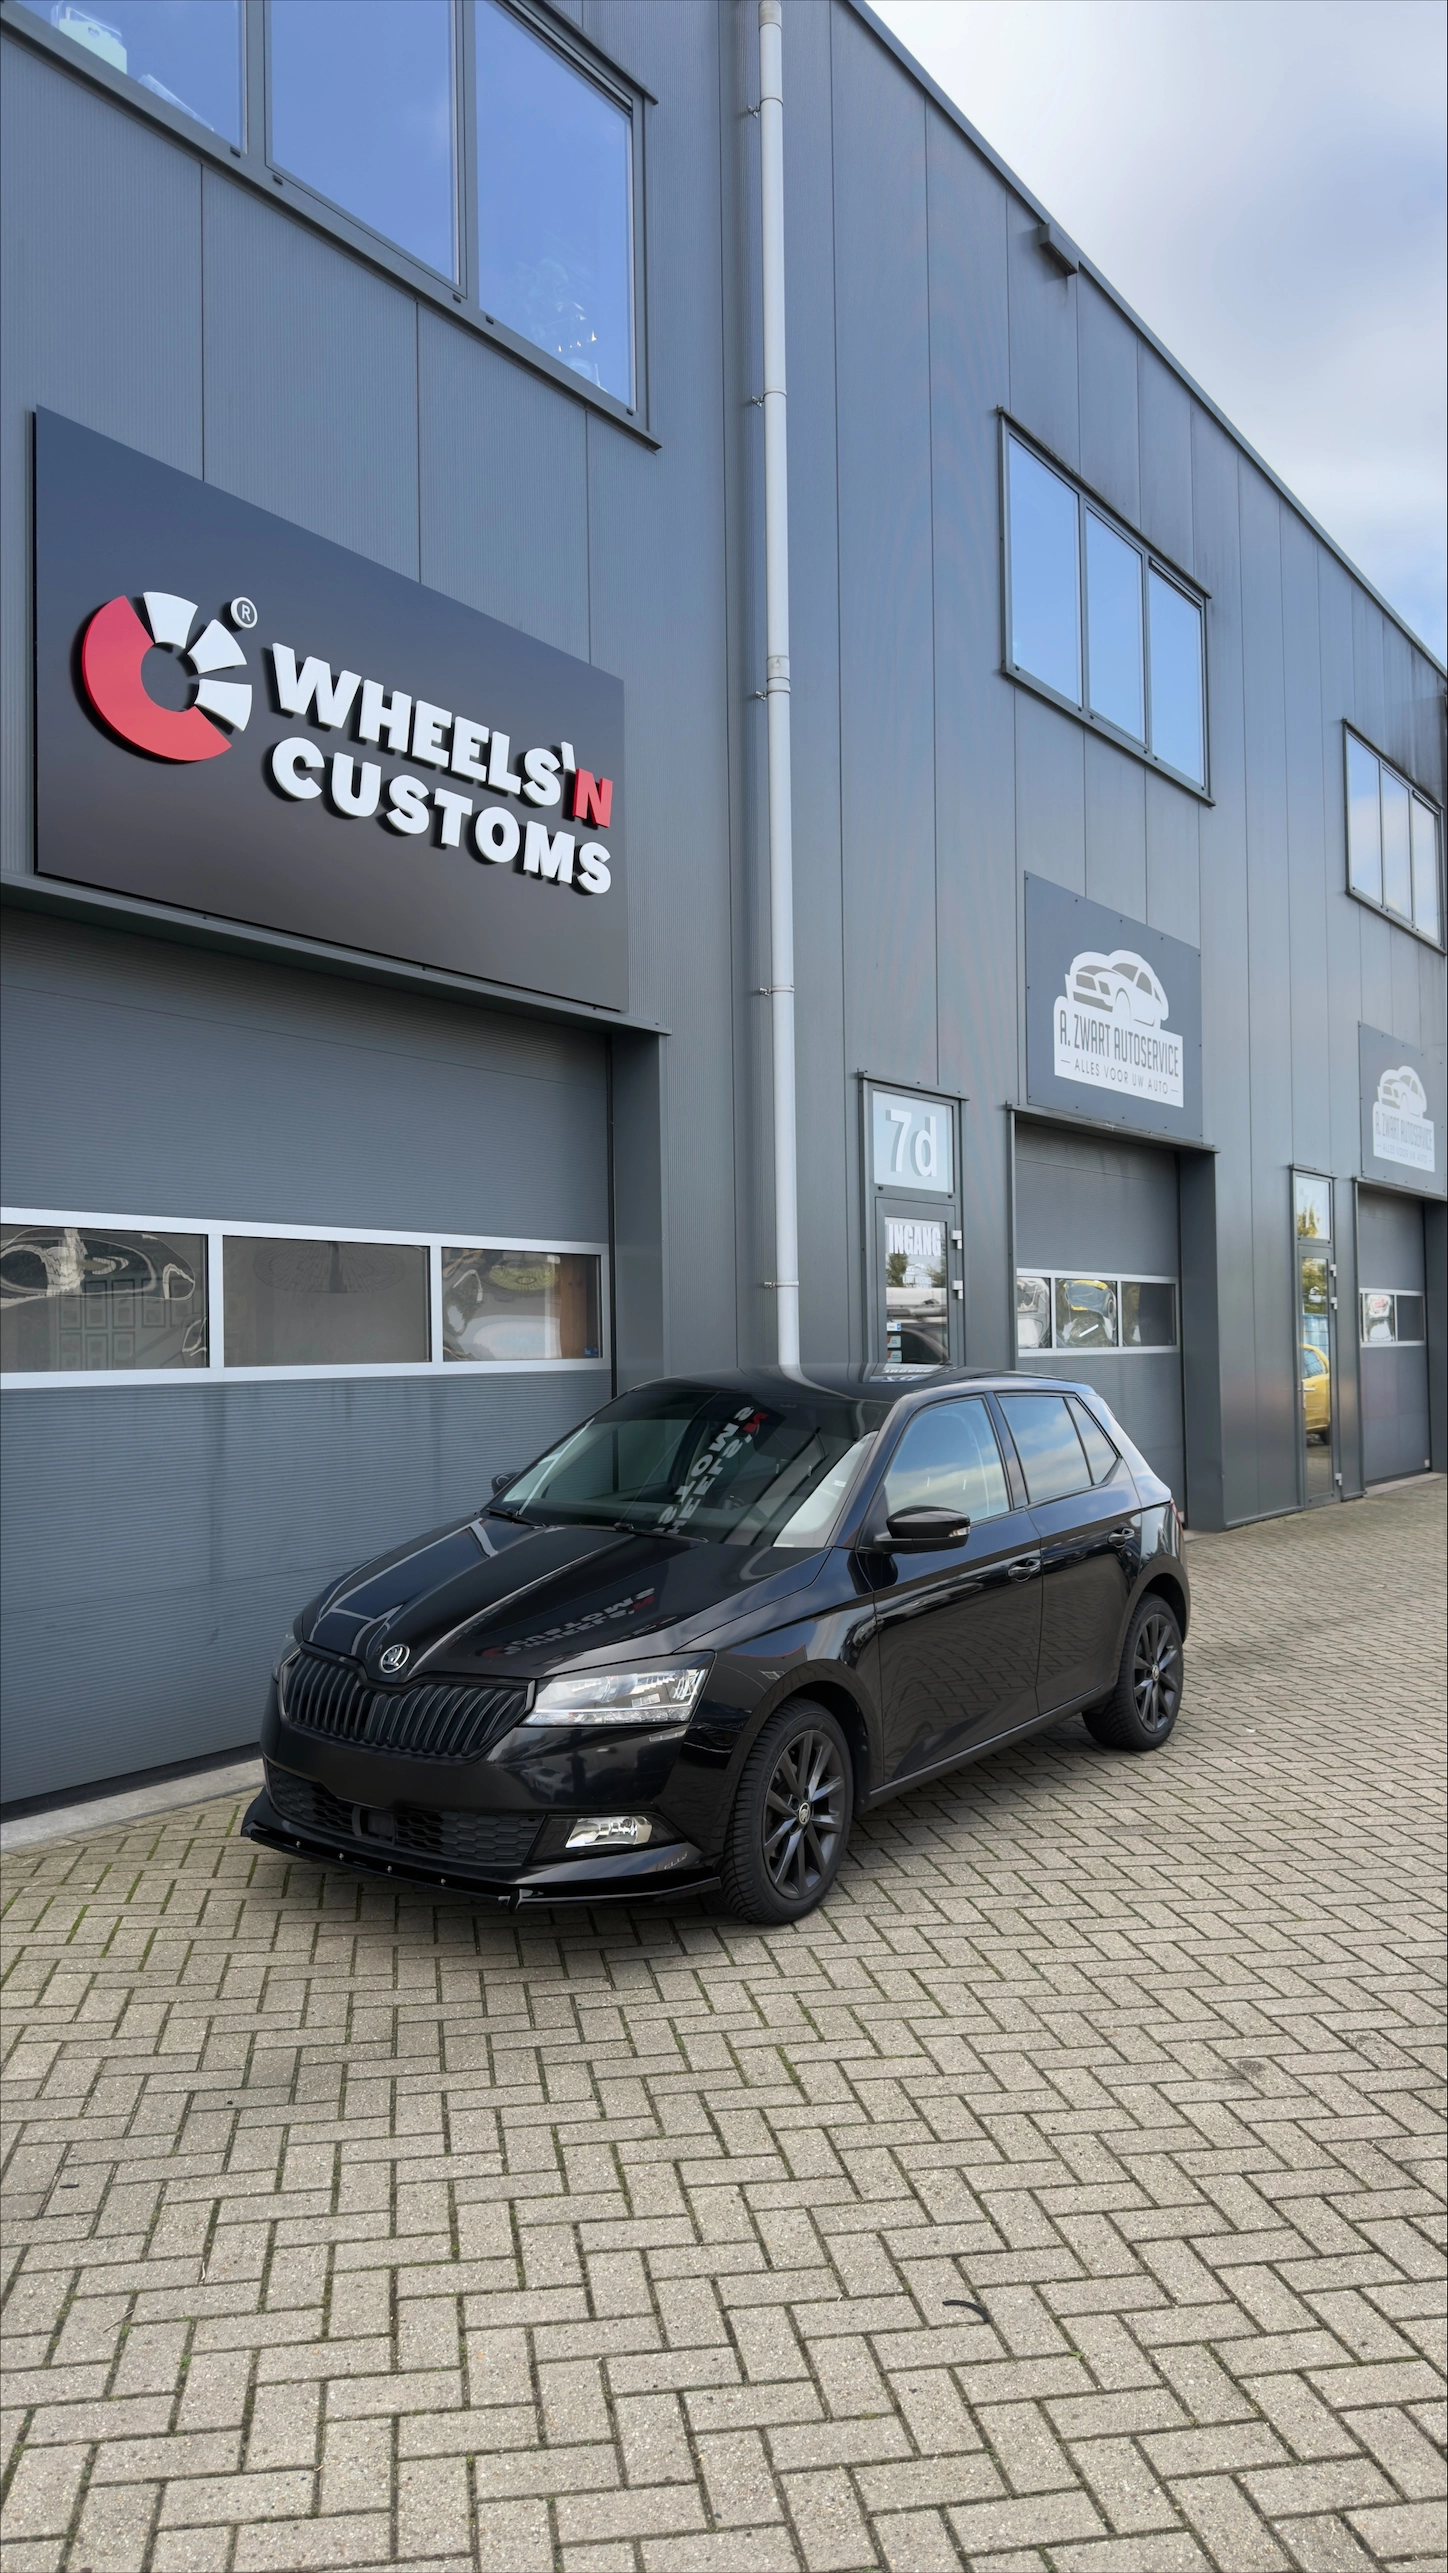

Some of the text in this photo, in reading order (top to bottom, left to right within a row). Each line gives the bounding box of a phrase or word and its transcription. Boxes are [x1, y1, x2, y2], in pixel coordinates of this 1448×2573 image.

[272, 737, 611, 894] CUSTOMS
[1060, 1009, 1179, 1078] A. ZWART AUTOSERVICE
[1074, 1058, 1169, 1095] ALLES VOOR UW AUTO
[886, 1108, 938, 1177] 7d
[888, 1223, 942, 1257] INGANG
